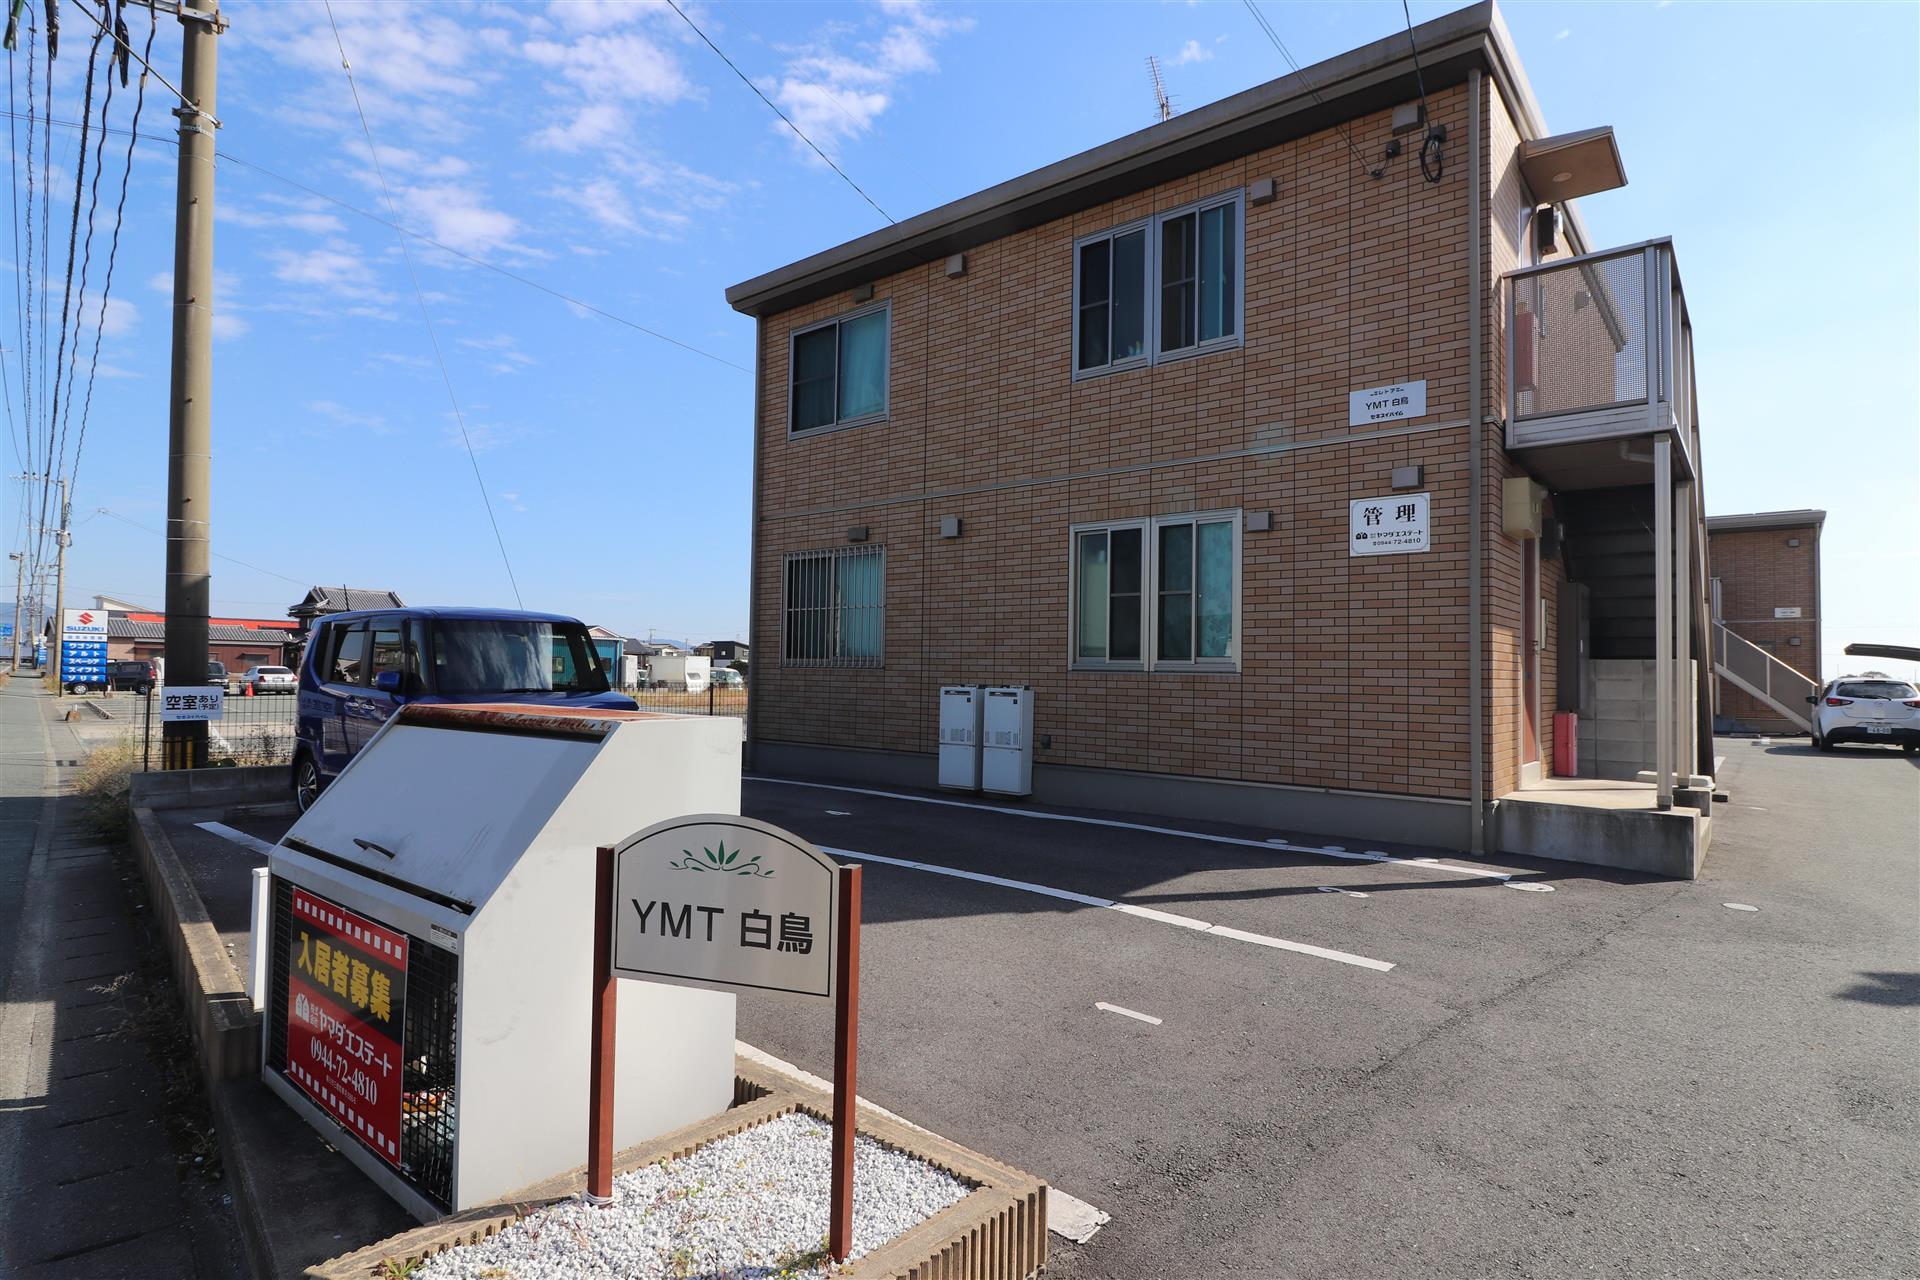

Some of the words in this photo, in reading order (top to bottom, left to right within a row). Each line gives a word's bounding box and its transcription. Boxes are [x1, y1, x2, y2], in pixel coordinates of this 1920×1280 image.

[1365, 399, 1389, 410] YMT
[1363, 503, 1416, 526] 管理
[631, 898, 725, 942] YMT
[740, 909, 813, 955] 白鳥
[297, 931, 391, 1023] 入居者募集
[310, 1035, 378, 1106] 0944-72-4810
[319, 1007, 393, 1078] ヤマダエステート
